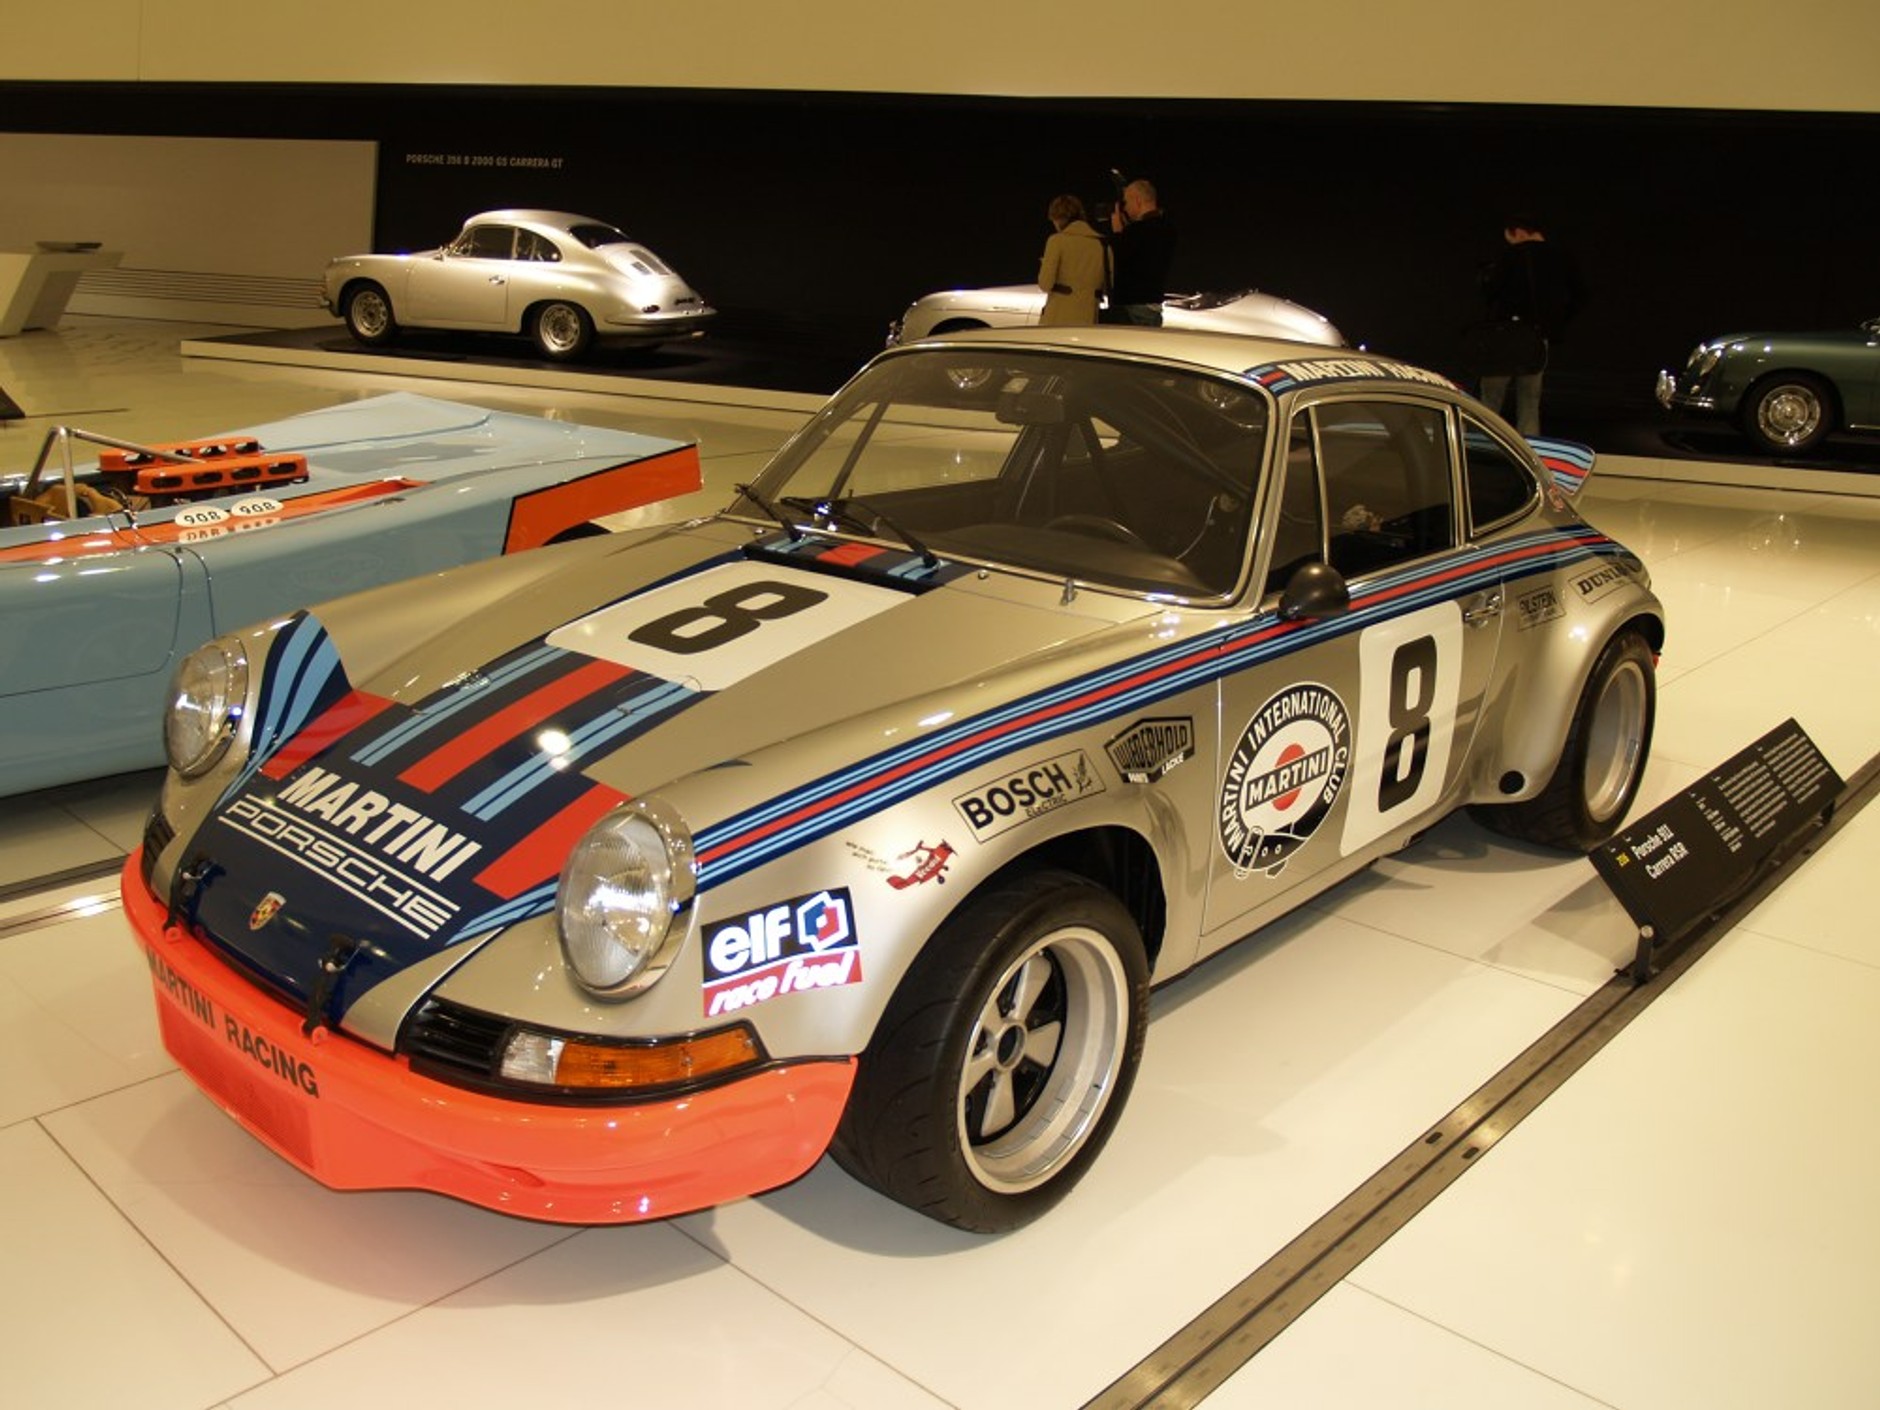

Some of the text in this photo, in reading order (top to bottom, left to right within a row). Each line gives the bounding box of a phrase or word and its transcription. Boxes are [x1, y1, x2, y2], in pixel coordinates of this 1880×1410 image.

[406, 154, 444, 164] PORSCHE
[471, 155, 493, 166] 2000
[509, 157, 549, 168] CARRERA
[551, 158, 563, 169] GT
[1277, 359, 1386, 382] MARTINI
[183, 511, 221, 524] 908
[239, 501, 275, 514] 908
[628, 580, 829, 655] 8
[1378, 634, 1437, 813] 8
[961, 763, 1073, 830] BOSCH
[1222, 691, 1347, 853] MARTINI INTERNATIONAL CLUB
[1248, 750, 1328, 806] MARTINI
[277, 767, 482, 882] MARTINI
[1631, 833, 1665, 860] Porsche
[226, 800, 453, 932] PORSCHE
[1645, 851, 1677, 879] Carrera
[709, 905, 791, 974] elf
[708, 951, 856, 1017] race fuel
[146, 944, 320, 1098] MARTINI RACING
